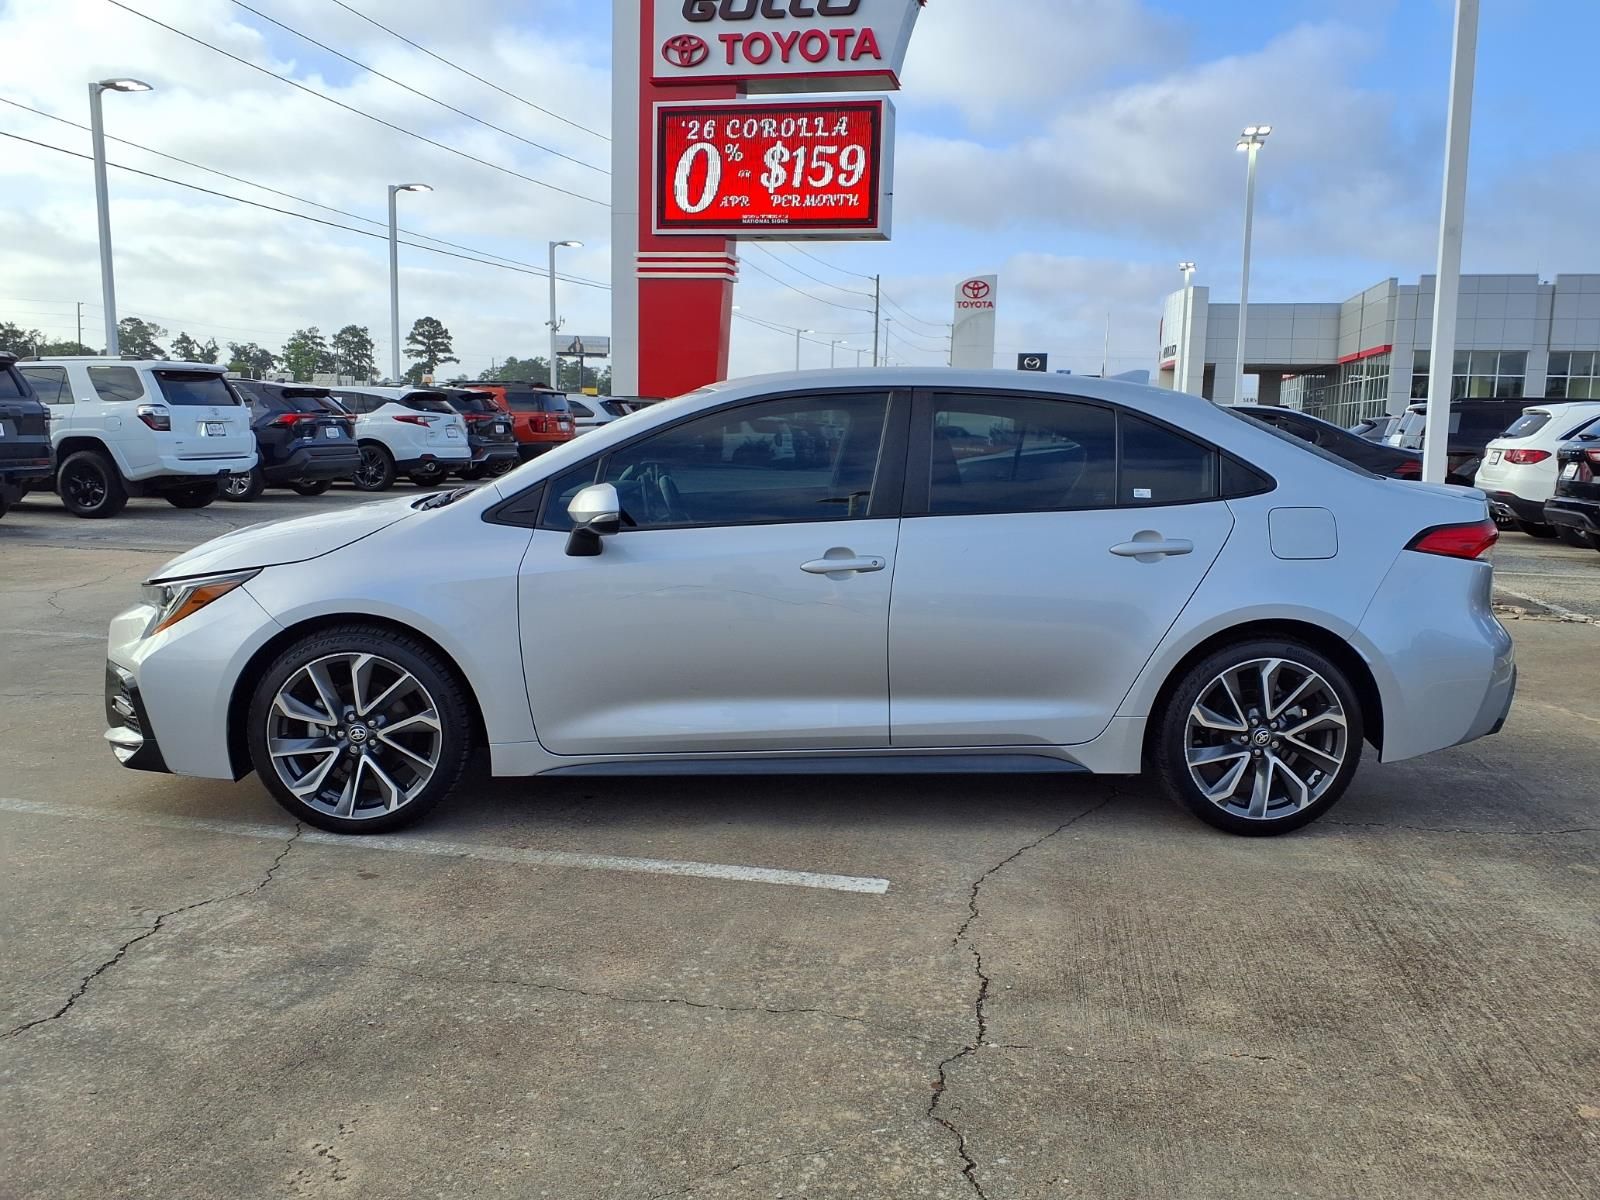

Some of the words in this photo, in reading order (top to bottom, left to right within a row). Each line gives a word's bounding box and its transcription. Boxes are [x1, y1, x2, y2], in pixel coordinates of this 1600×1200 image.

[718, 27, 881, 65] TOYOTA
[726, 116, 849, 138] COROLLA
[760, 140, 866, 194] $159
[720, 195, 750, 207] APR
[770, 194, 801, 207] PER
[802, 193, 860, 207] MONTH
[957, 300, 994, 309] TOYOTA
